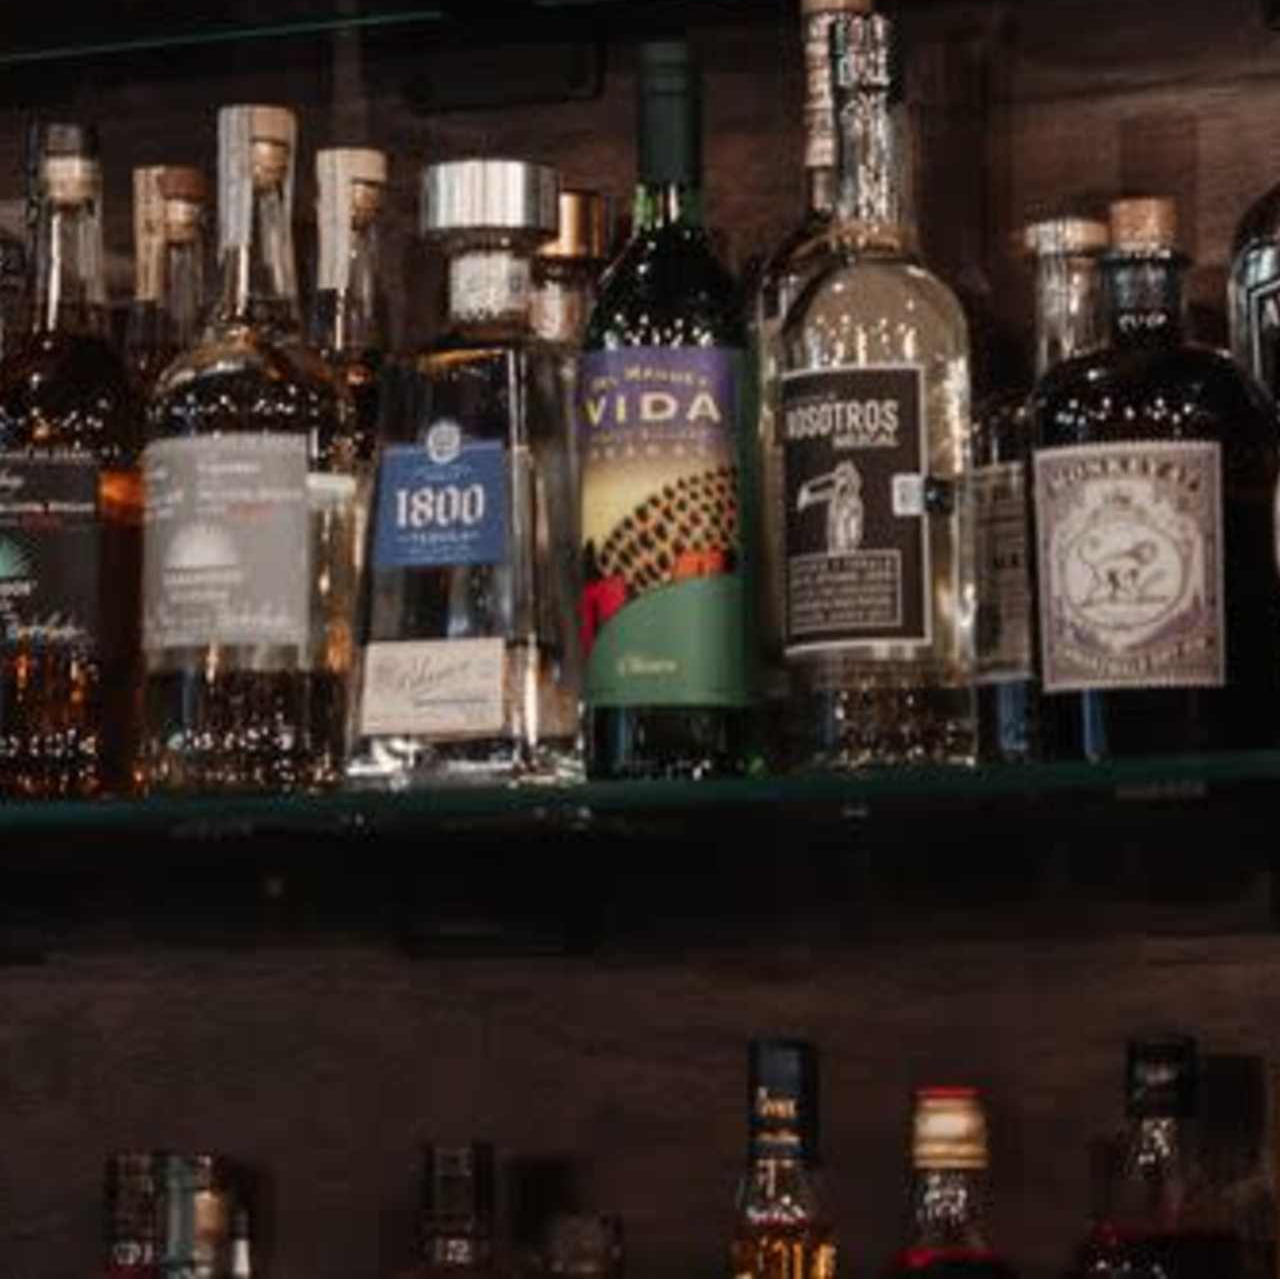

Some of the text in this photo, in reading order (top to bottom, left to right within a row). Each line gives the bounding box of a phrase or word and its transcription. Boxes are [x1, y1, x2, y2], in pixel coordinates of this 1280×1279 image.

[582, 390, 722, 427] VIDA
[786, 399, 900, 440] NOSOTROS
[395, 483, 486, 528] 1800
